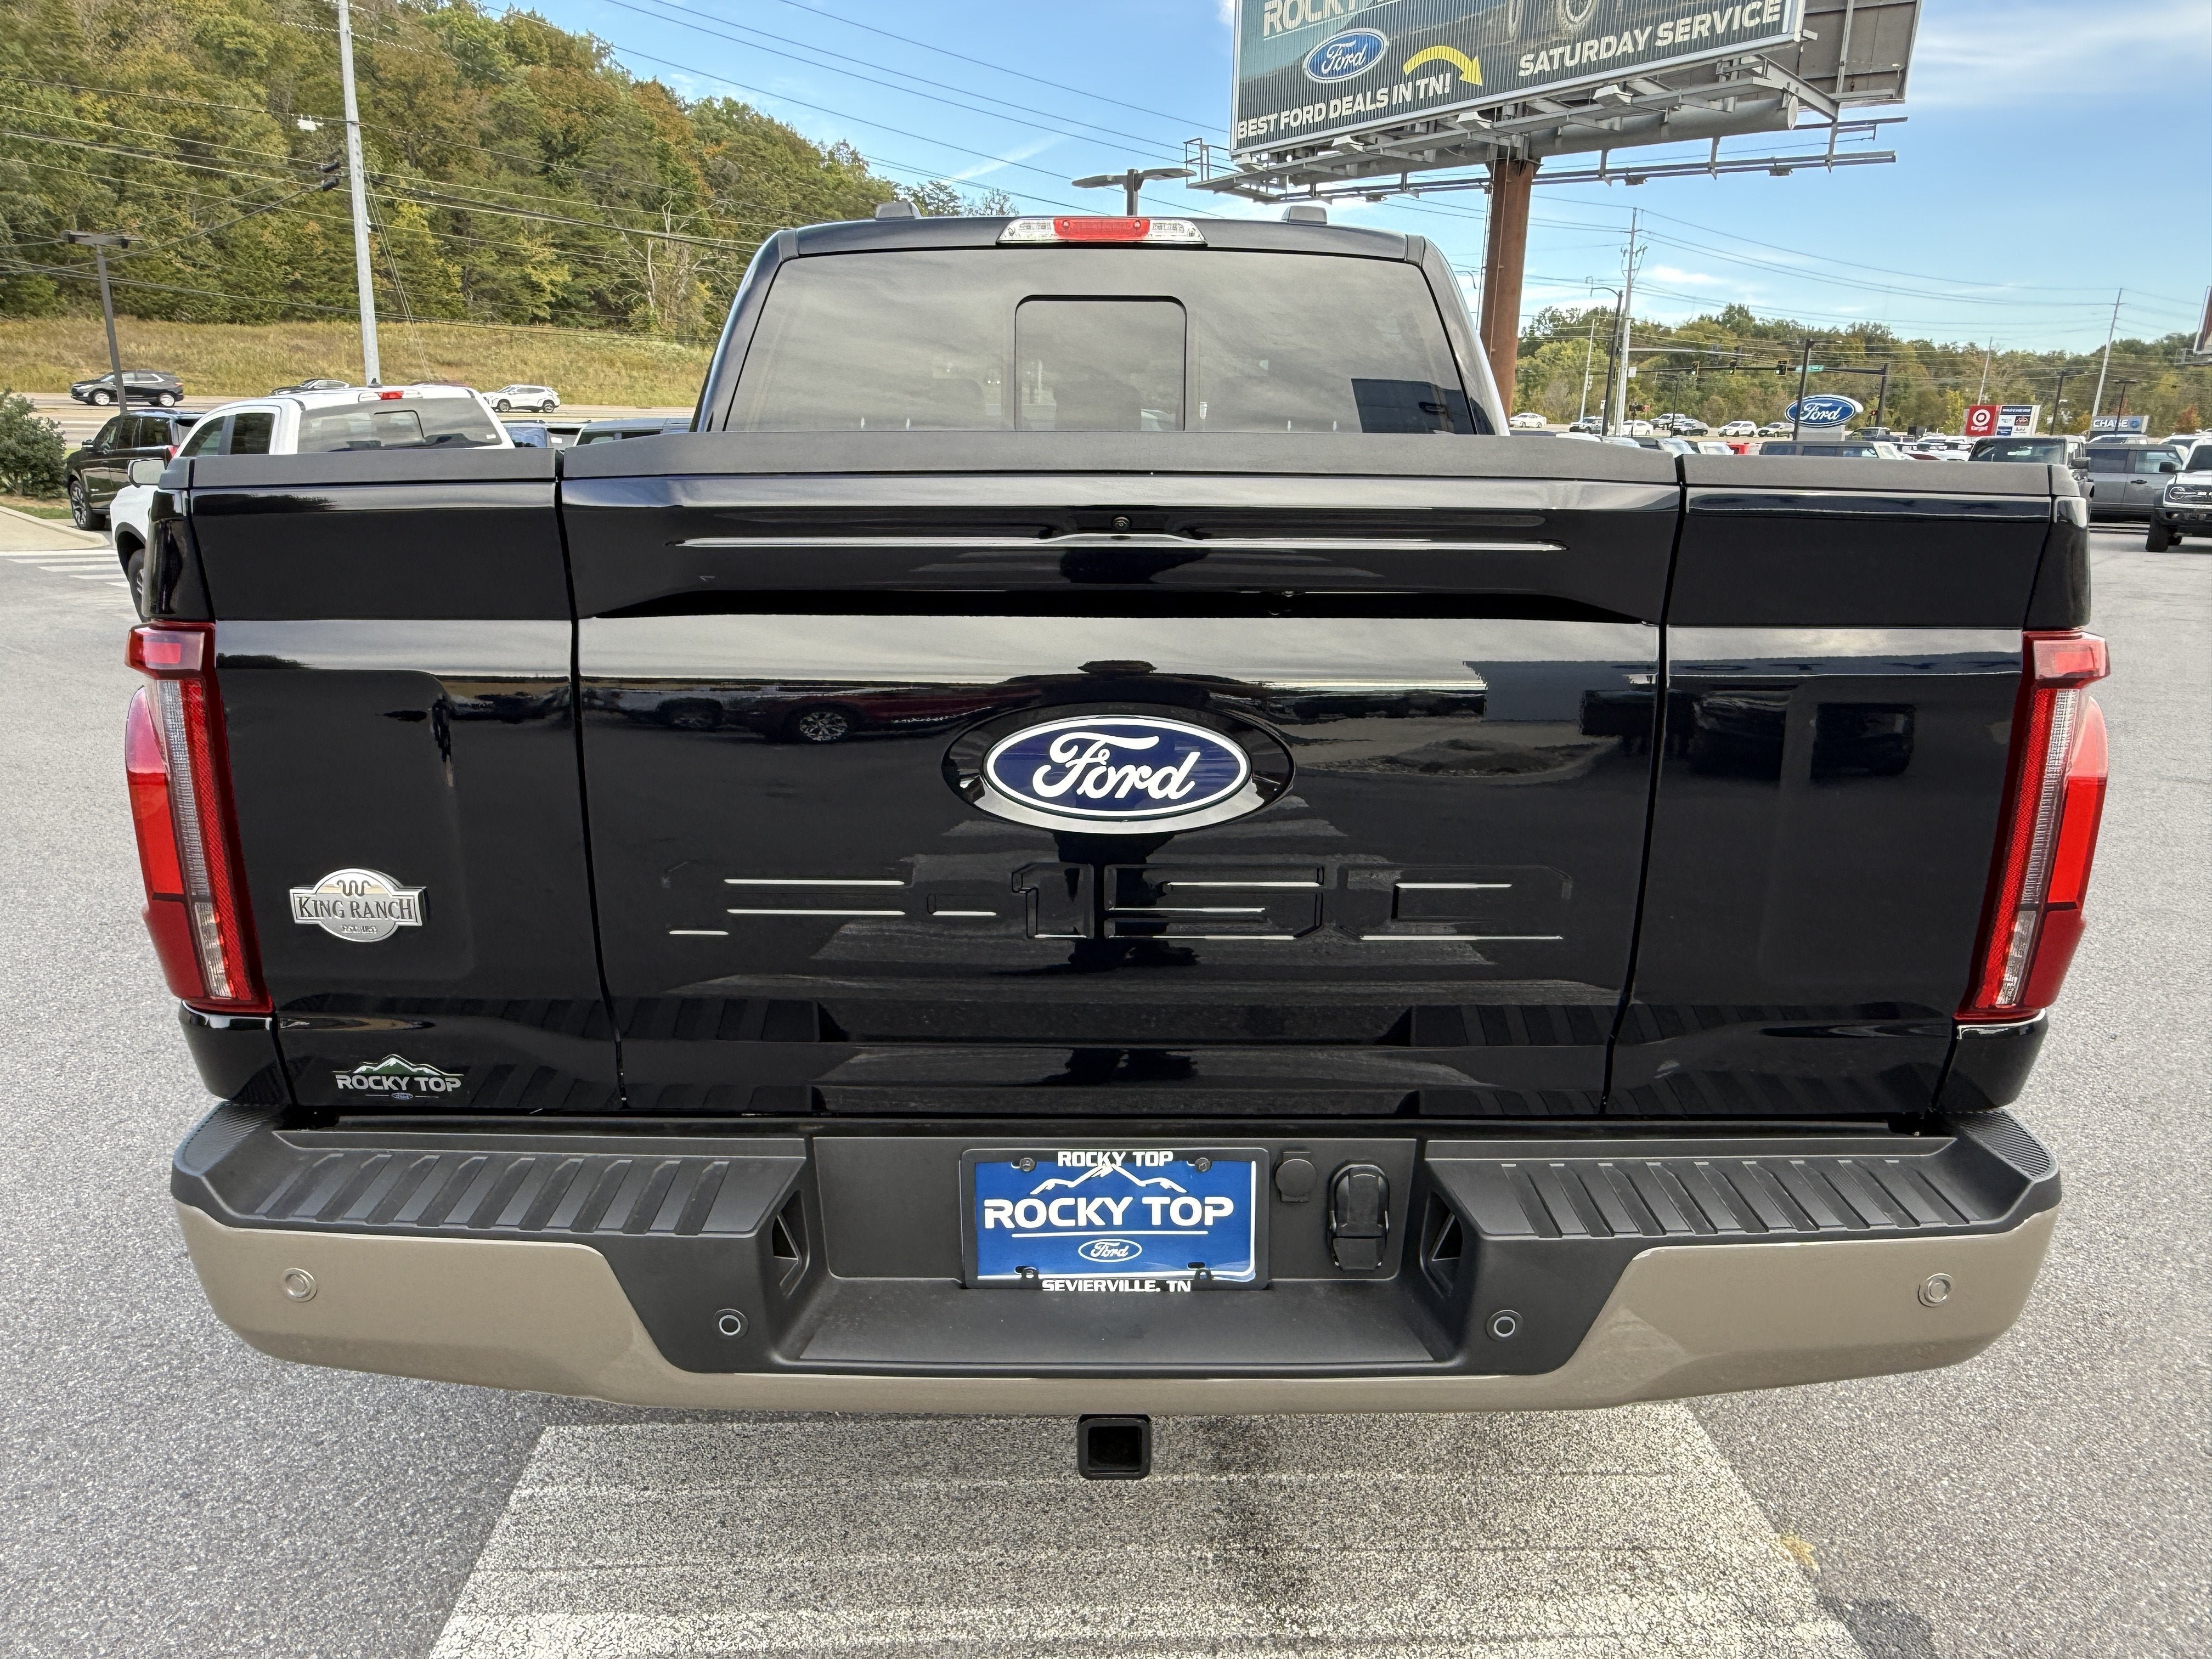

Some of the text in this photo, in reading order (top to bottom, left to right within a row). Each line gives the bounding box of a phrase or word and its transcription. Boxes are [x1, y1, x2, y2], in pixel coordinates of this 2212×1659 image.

[1518, 0, 1782, 77] SATURDAY SERVICE
[1321, 39, 1368, 75] Ford
[1238, 72, 1451, 139] BEST FORD DEALS IN TN!
[1800, 402, 1843, 421] Ford
[1032, 732, 1200, 800] Ford
[295, 896, 413, 920] KING RANCH
[335, 1074, 462, 1092] ROCKY TOP
[1057, 1150, 1173, 1167] ROCKY TOP
[984, 1196, 1234, 1229] ROCKY TOP
[1090, 1242, 1130, 1257] Ford
[1166, 1279, 1191, 1293] TN
